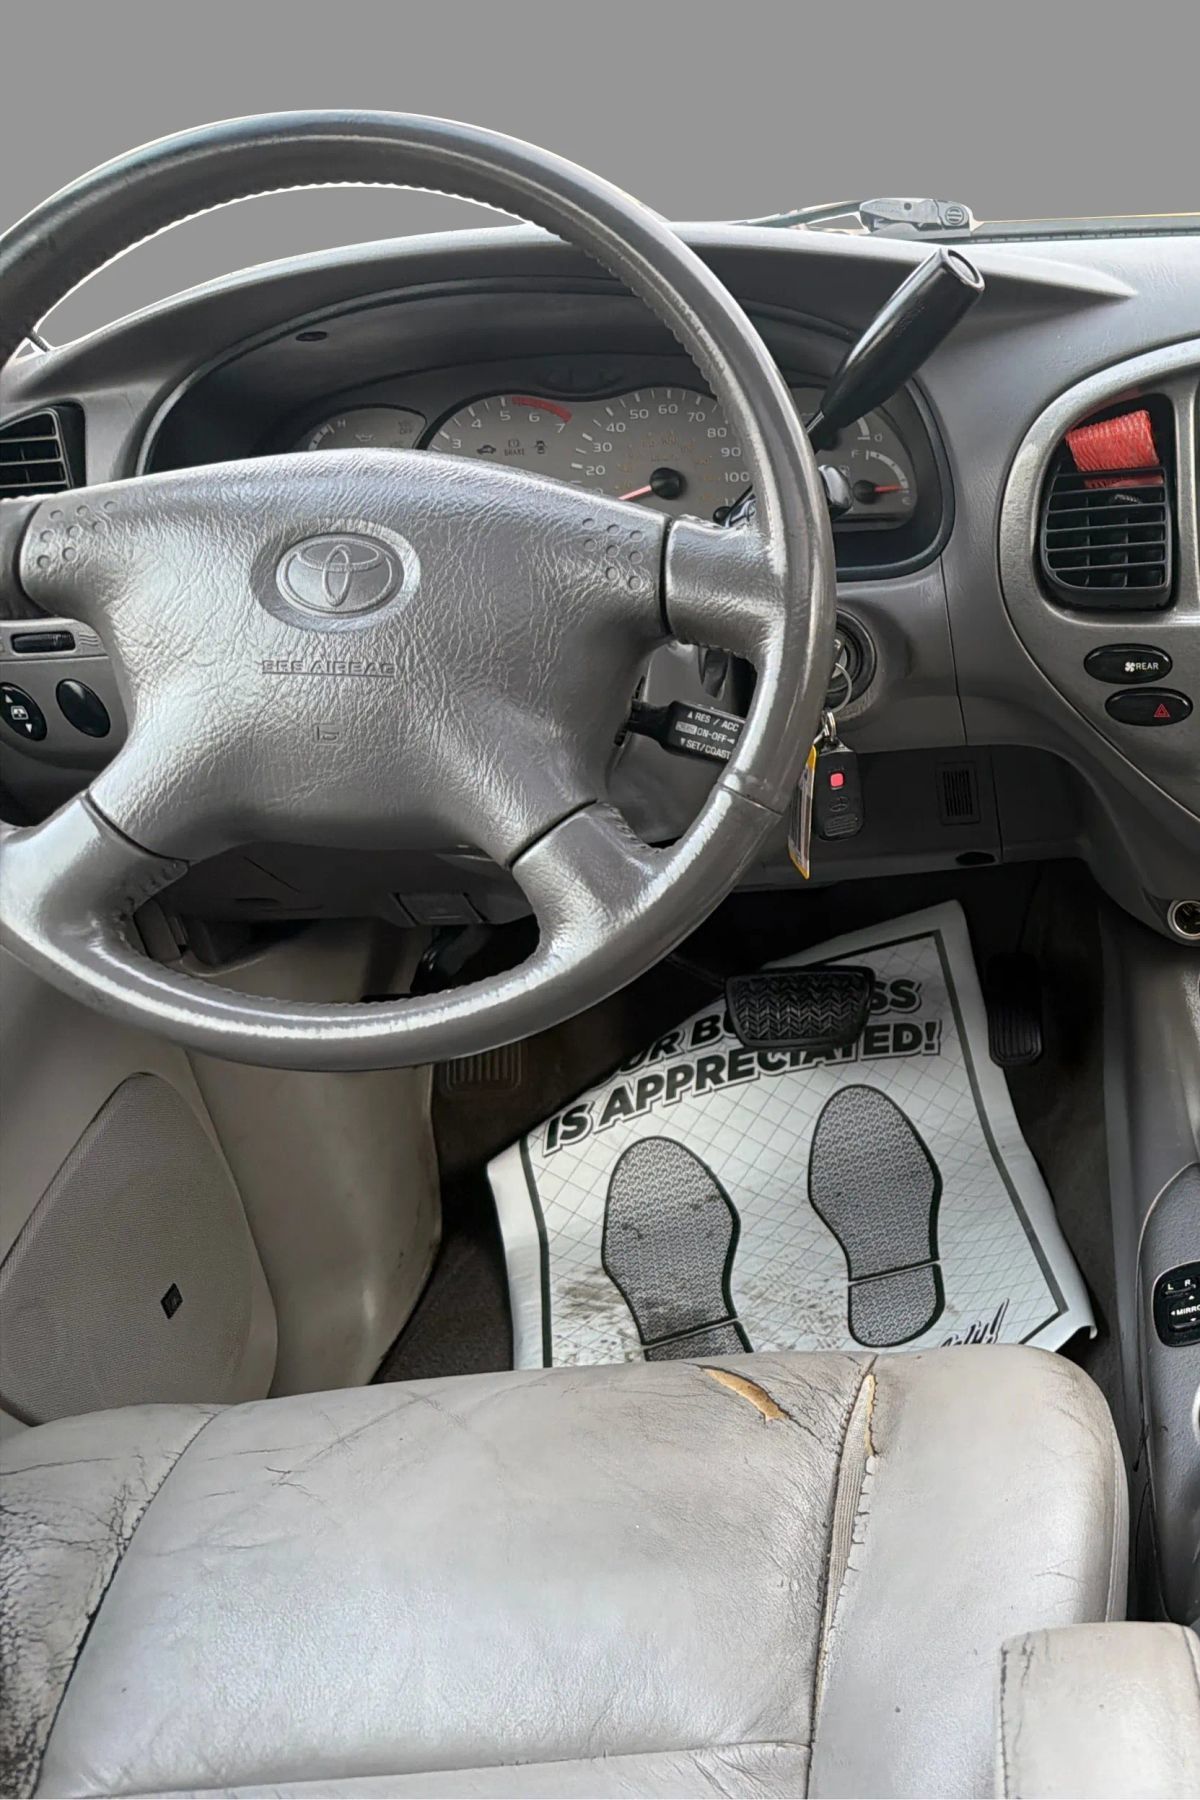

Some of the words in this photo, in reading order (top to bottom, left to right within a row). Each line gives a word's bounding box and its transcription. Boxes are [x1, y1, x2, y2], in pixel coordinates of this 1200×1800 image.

[629, 409, 649, 420] 50
[658, 404, 678, 414] 60
[500, 410, 511, 421] 5
[528, 412, 541, 423] 6
[687, 411, 706, 422] 70
[471, 418, 481, 429] 4
[555, 423, 566, 434] 7
[605, 422, 626, 433] 40
[707, 427, 728, 438] 80
[452, 439, 461, 449] 3
[593, 442, 613, 453] 30
[721, 447, 742, 458] 90
[586, 465, 606, 476] 20
[724, 471, 750, 482] 100
[310, 660, 395, 675] AIRBAG
[1136, 662, 1159, 671] REAR
[694, 711, 712, 724] RES
[721, 720, 740, 732] ACC
[697, 727, 728, 743] ON-OFF
[544, 1102, 593, 1156] IS
[1167, 1283, 1174, 1291] L
[1184, 1279, 1191, 1287] R
